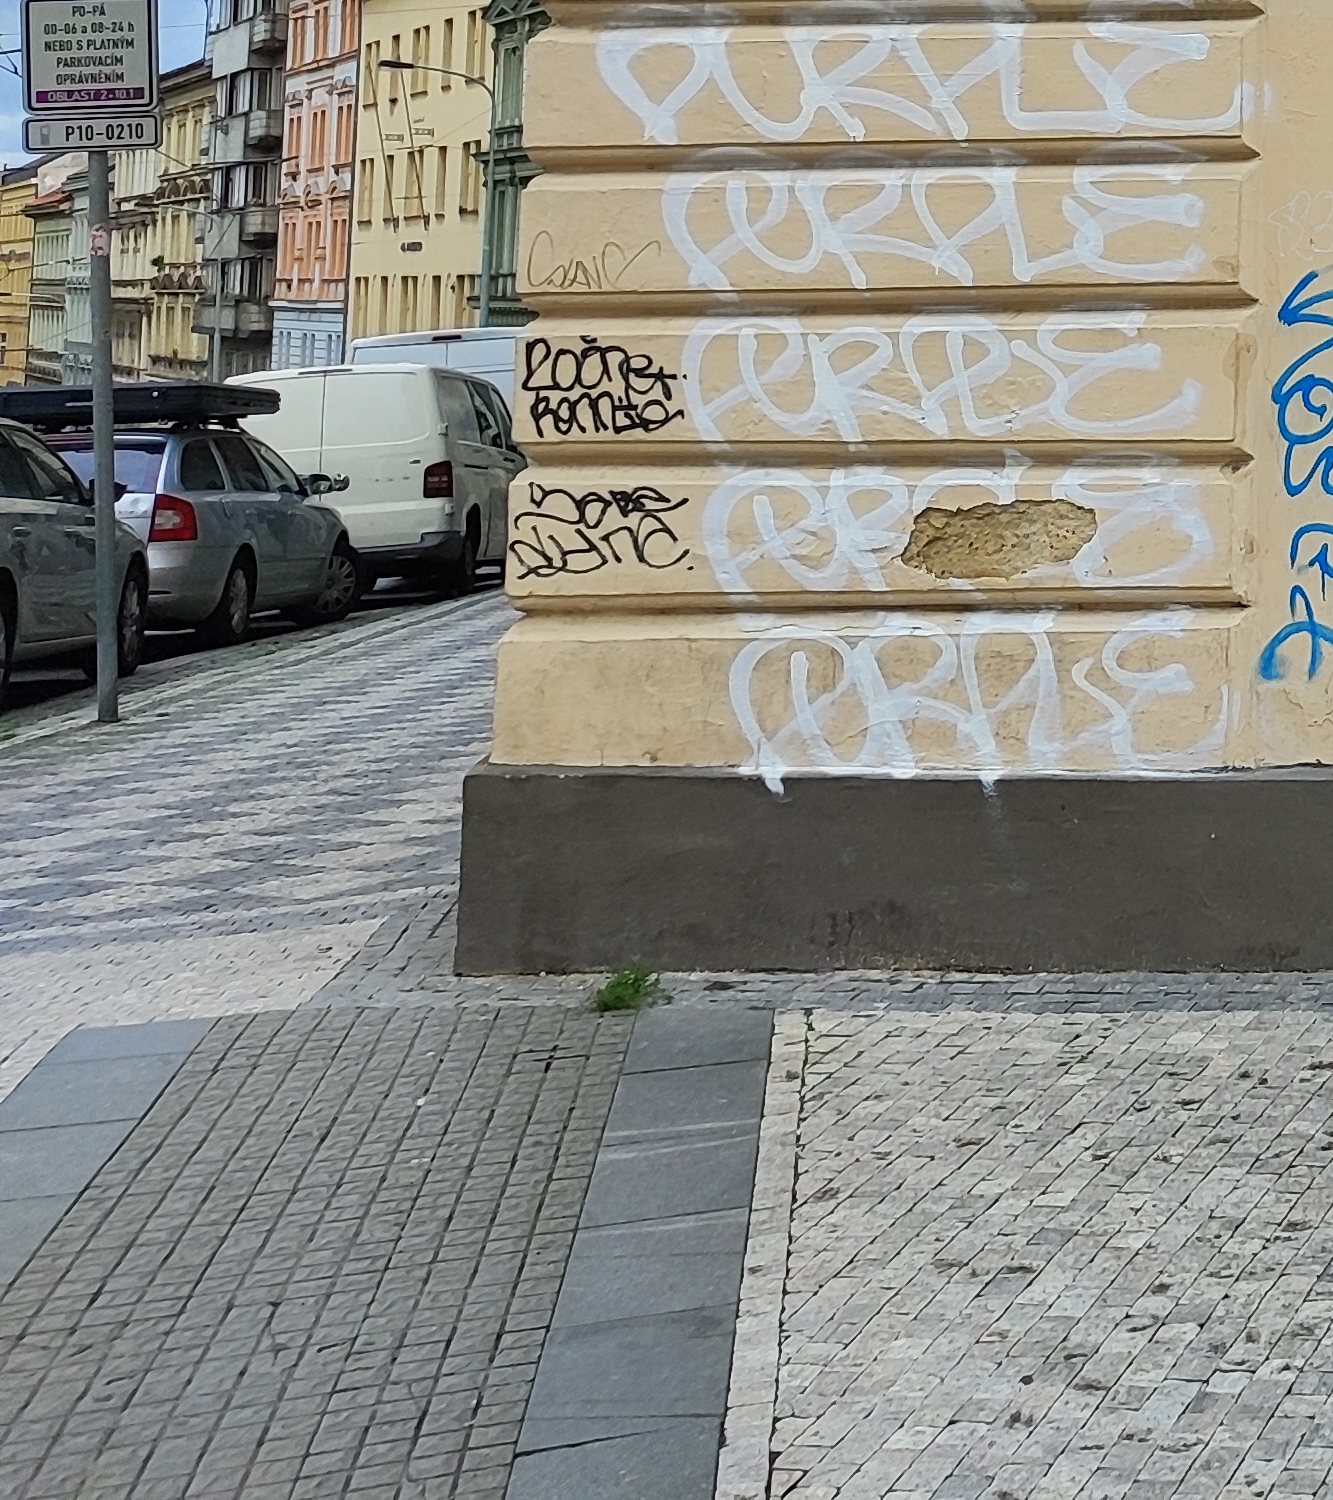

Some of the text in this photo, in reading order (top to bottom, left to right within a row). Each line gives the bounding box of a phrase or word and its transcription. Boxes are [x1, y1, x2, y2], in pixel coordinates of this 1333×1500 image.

[72, 2, 107, 18] PO-PÁ
[80, 25, 88, 34] a
[127, 21, 135, 33] h
[44, 36, 135, 53] NEBO S PLATNÝM
[56, 53, 124, 69] PARKOVACÍM
[56, 69, 125, 86] OPRÁVNĚNÍM
[47, 89, 96, 102] OBLAST
[64, 122, 144, 143] P10-0210
